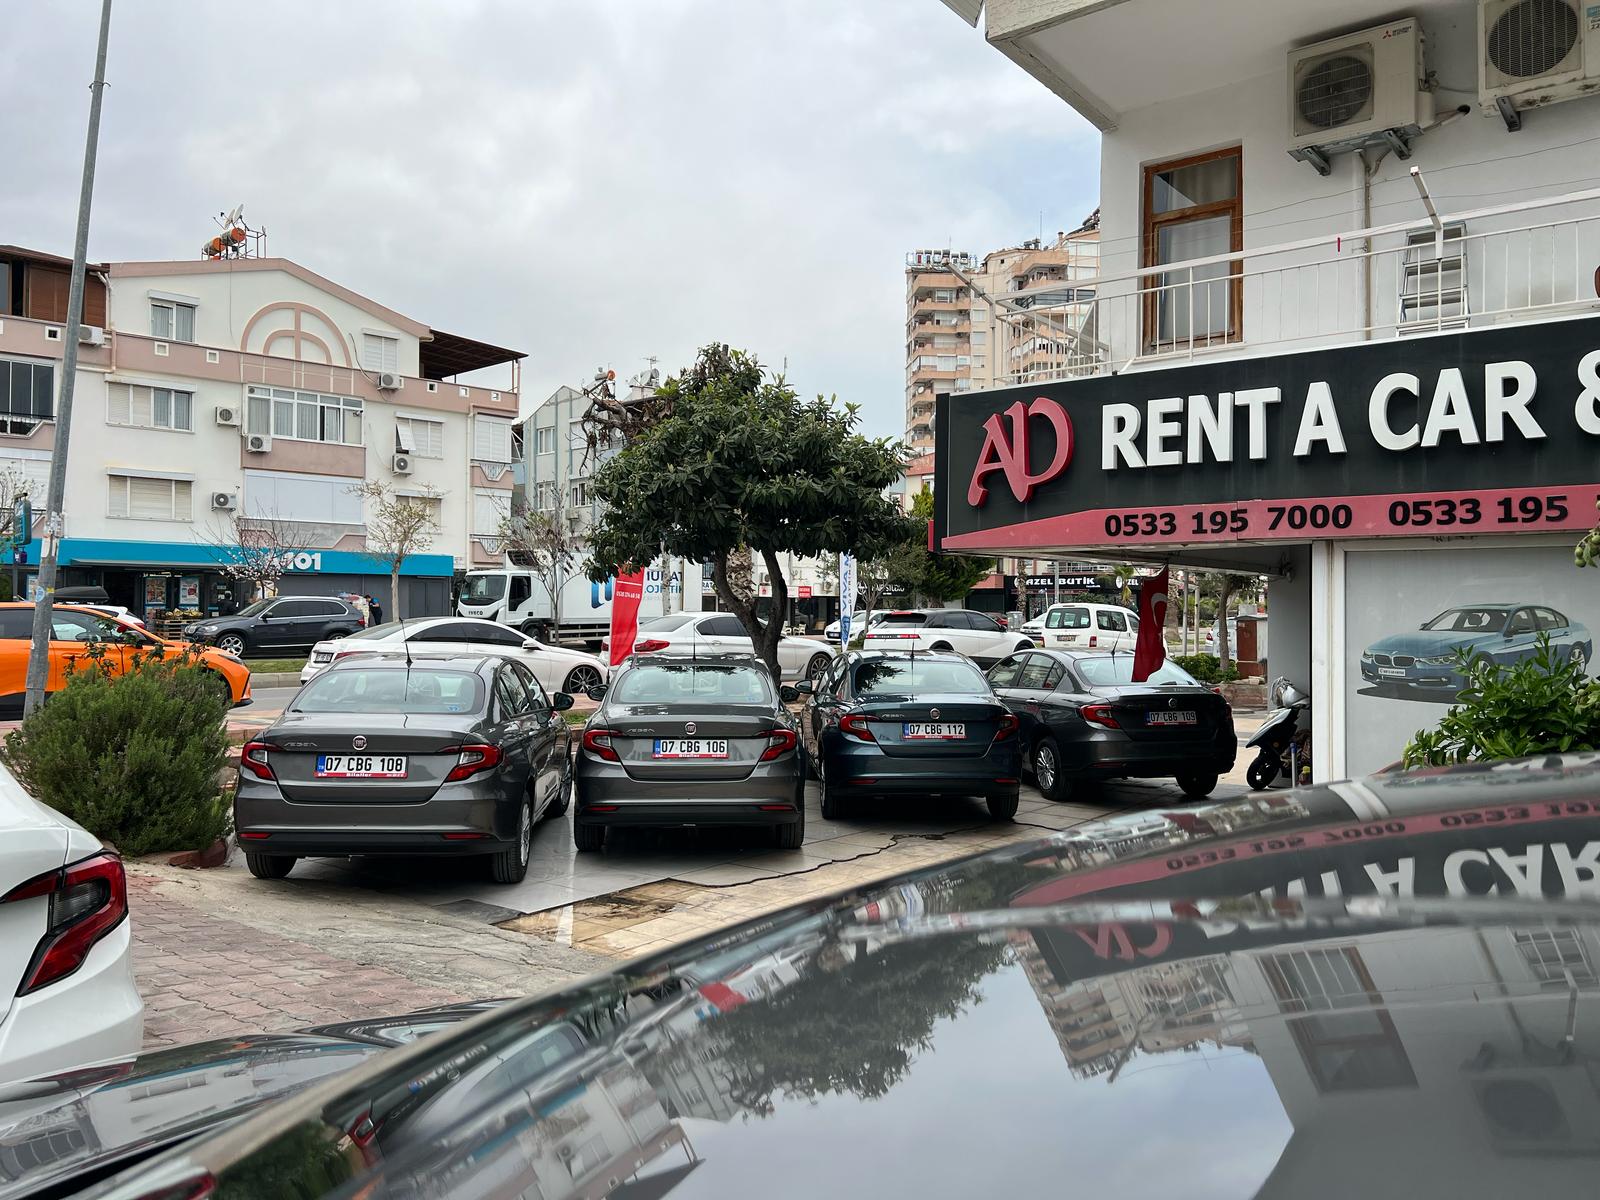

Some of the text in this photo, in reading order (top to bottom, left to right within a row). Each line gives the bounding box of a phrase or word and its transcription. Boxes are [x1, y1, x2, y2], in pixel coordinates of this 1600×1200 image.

[1101, 386, 1282, 470] RENT
[1293, 381, 1348, 456] A
[1369, 360, 1548, 451] CAR
[1388, 498, 1482, 527] 0533
[1496, 495, 1569, 524] 195
[1104, 504, 1353, 537] 0533 195 7000
[1150, 712, 1160, 722] 07
[1182, 711, 1196, 721] 109
[909, 724, 964, 735] 07 CBG 112
[661, 741, 725, 753] 07 CBG 106
[325, 757, 403, 772] 07 CBG 108
